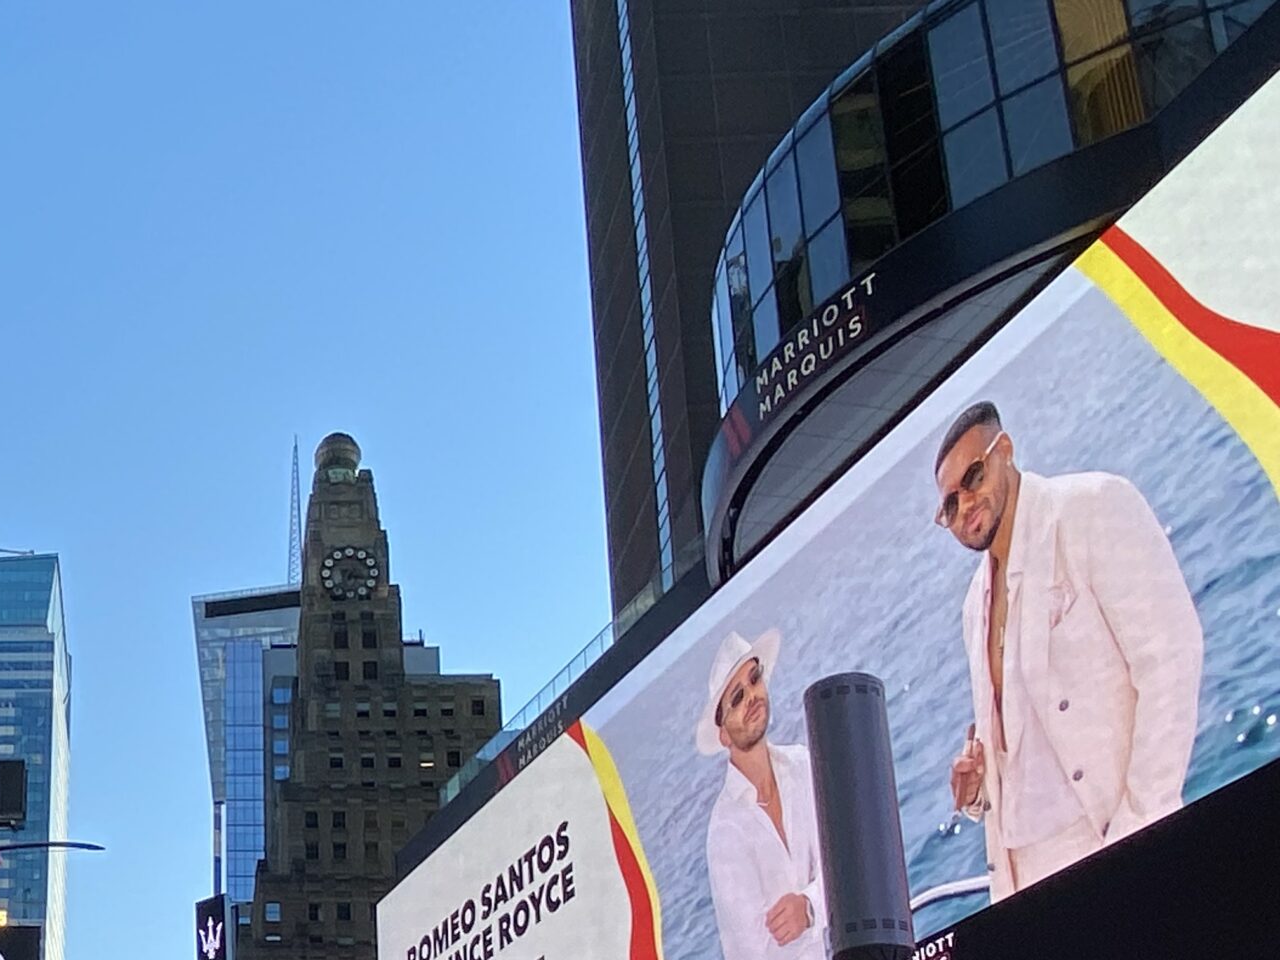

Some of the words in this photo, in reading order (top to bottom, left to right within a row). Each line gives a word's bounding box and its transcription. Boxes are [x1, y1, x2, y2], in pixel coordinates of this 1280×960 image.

[756, 272, 876, 394] MARRIOTT
[759, 315, 862, 420] MARQUIS
[517, 693, 569, 751] MARRIOTT
[518, 719, 564, 769] MARQUIS
[481, 821, 569, 920] SANTOS
[498, 862, 576, 951] ROYCE
